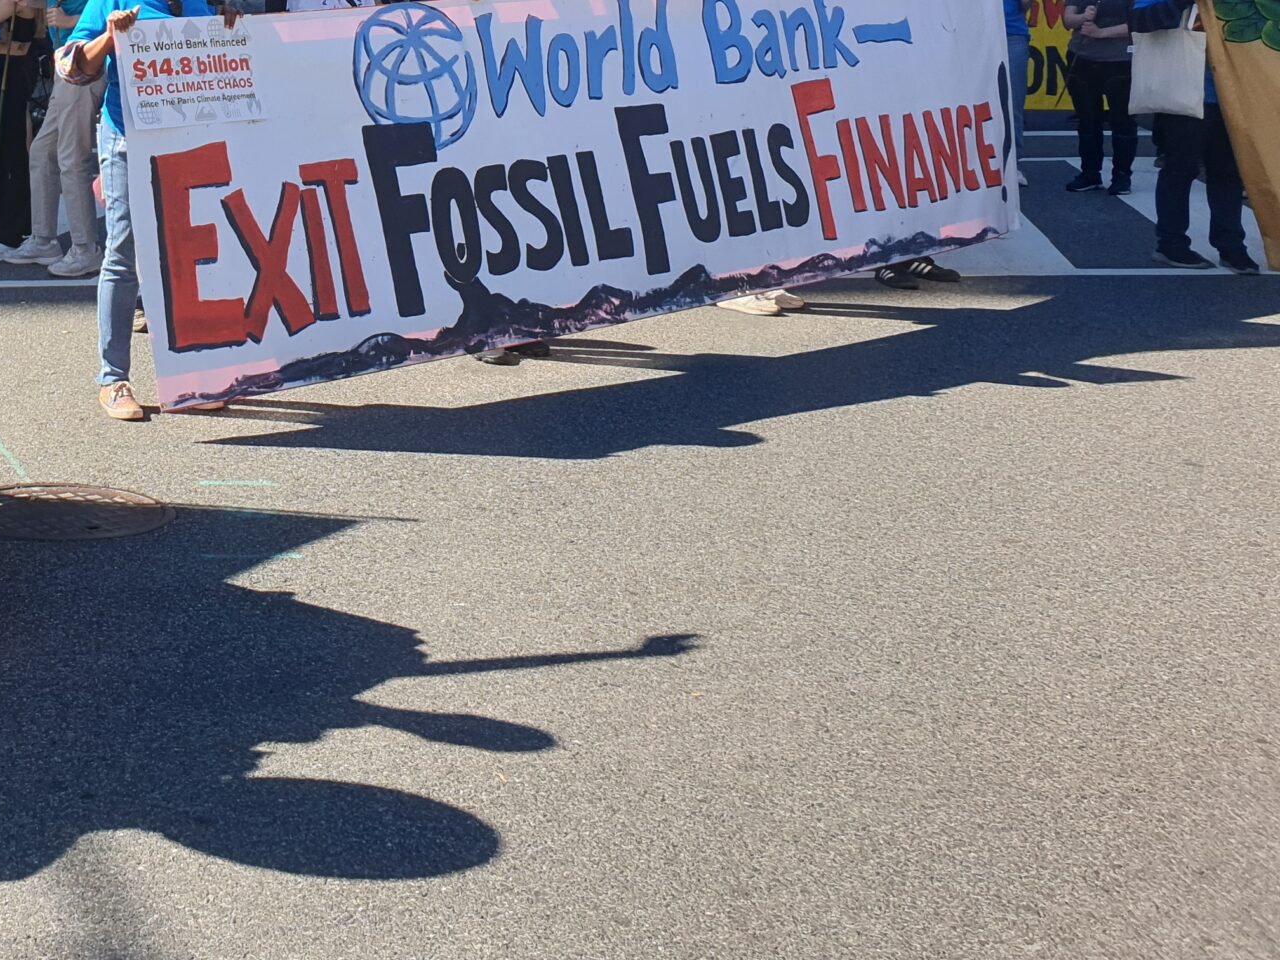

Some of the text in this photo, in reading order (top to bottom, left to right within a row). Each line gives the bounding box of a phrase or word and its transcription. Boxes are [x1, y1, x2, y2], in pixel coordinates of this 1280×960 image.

[130, 37, 247, 54] The World Bank financed
[133, 53, 250, 81] $14.8 billion
[137, 78, 253, 96] FOR CLIMATE CHAOS
[161, 99, 175, 107] The
[177, 96, 195, 105] Paris
[197, 94, 220, 103] Climate
[222, 92, 256, 102] Agreement
[150, 142, 370, 353] EXIT
[362, 122, 632, 318] FOSSIL
[614, 103, 810, 276] FUELS
